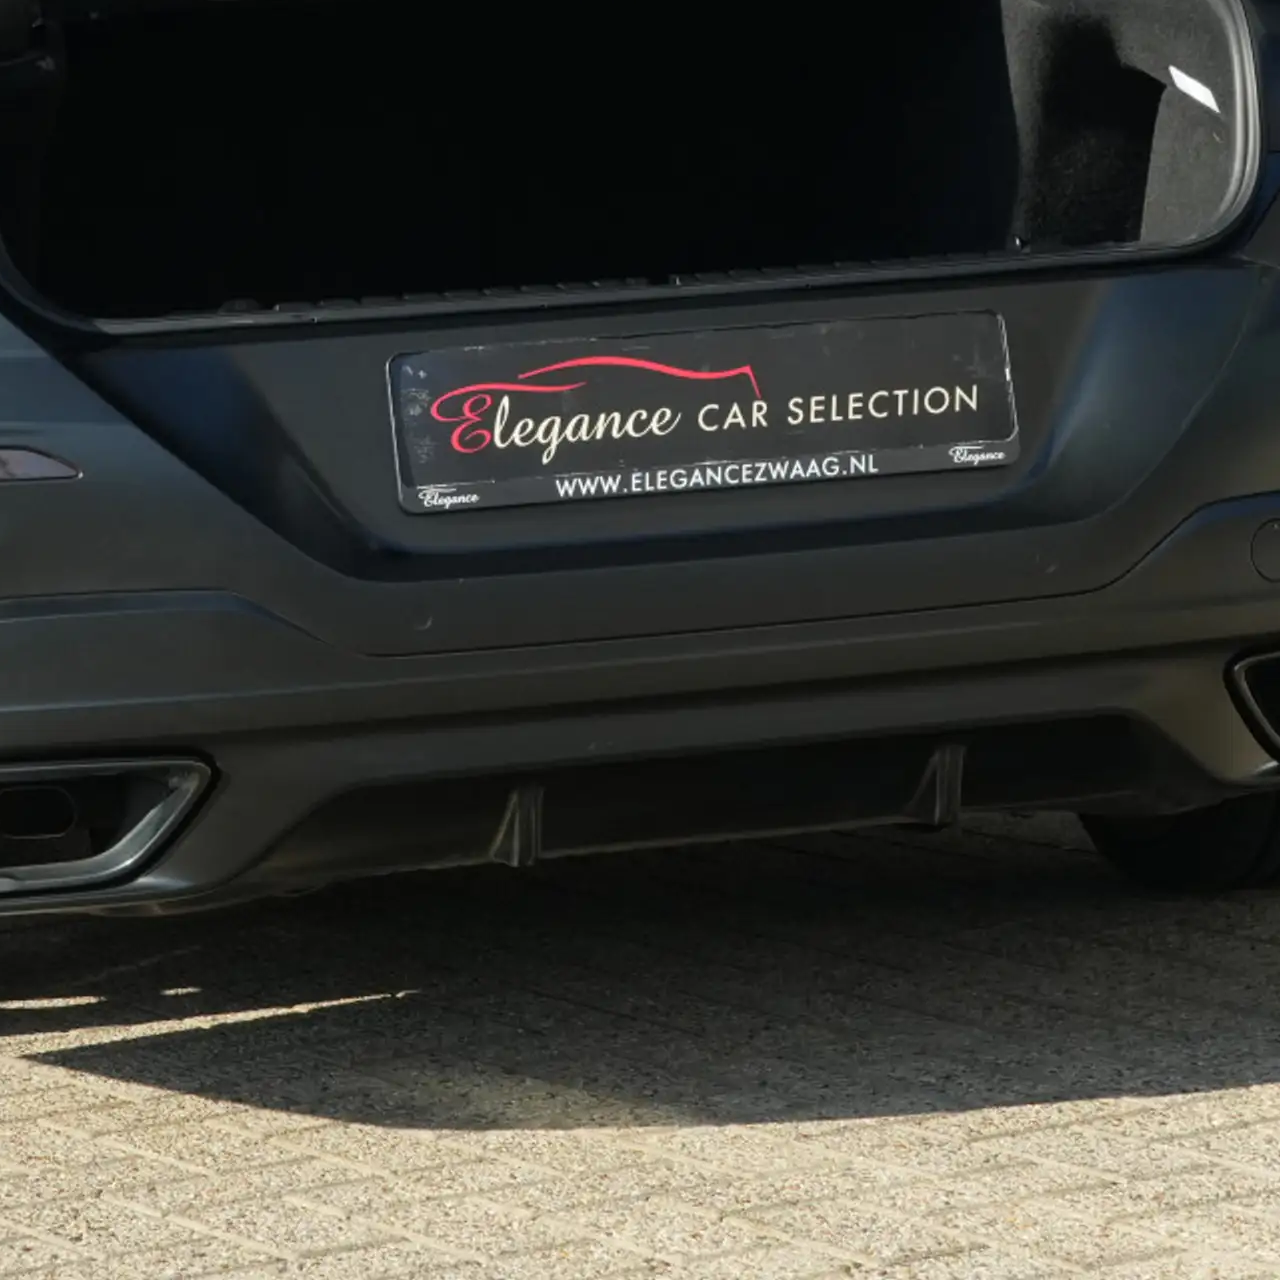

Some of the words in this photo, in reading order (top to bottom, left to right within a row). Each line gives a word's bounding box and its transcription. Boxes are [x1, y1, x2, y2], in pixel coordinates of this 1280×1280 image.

[431, 392, 682, 464] Elegance
[698, 399, 768, 432] CAR
[787, 385, 979, 426] SELECTION
[556, 457, 879, 498] WWW.ELEGANCEZWAAG.NL
[418, 488, 480, 509] Elegance
